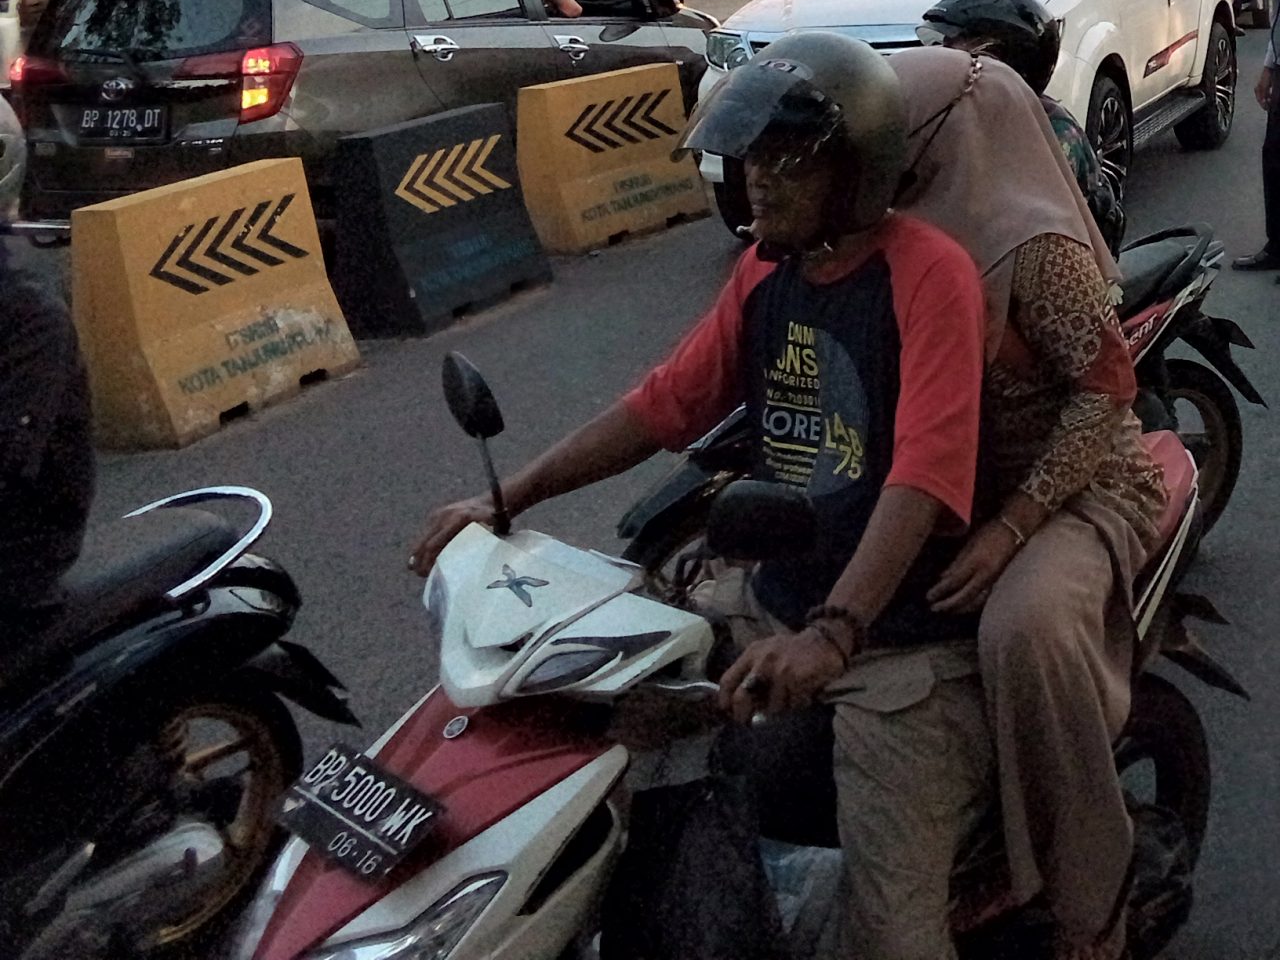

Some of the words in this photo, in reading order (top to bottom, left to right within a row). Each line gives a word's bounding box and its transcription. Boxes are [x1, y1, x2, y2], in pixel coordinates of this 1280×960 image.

[81, 110, 100, 128] BP
[106, 109, 137, 129] 1278
[144, 109, 161, 128] DT
[776, 344, 819, 377] JNS
[178, 365, 224, 395] KOTA
[825, 412, 864, 458] LAB
[833, 444, 863, 480] 75
[303, 748, 348, 786] BP
[330, 765, 397, 823] 5000
[380, 797, 434, 845] WK
